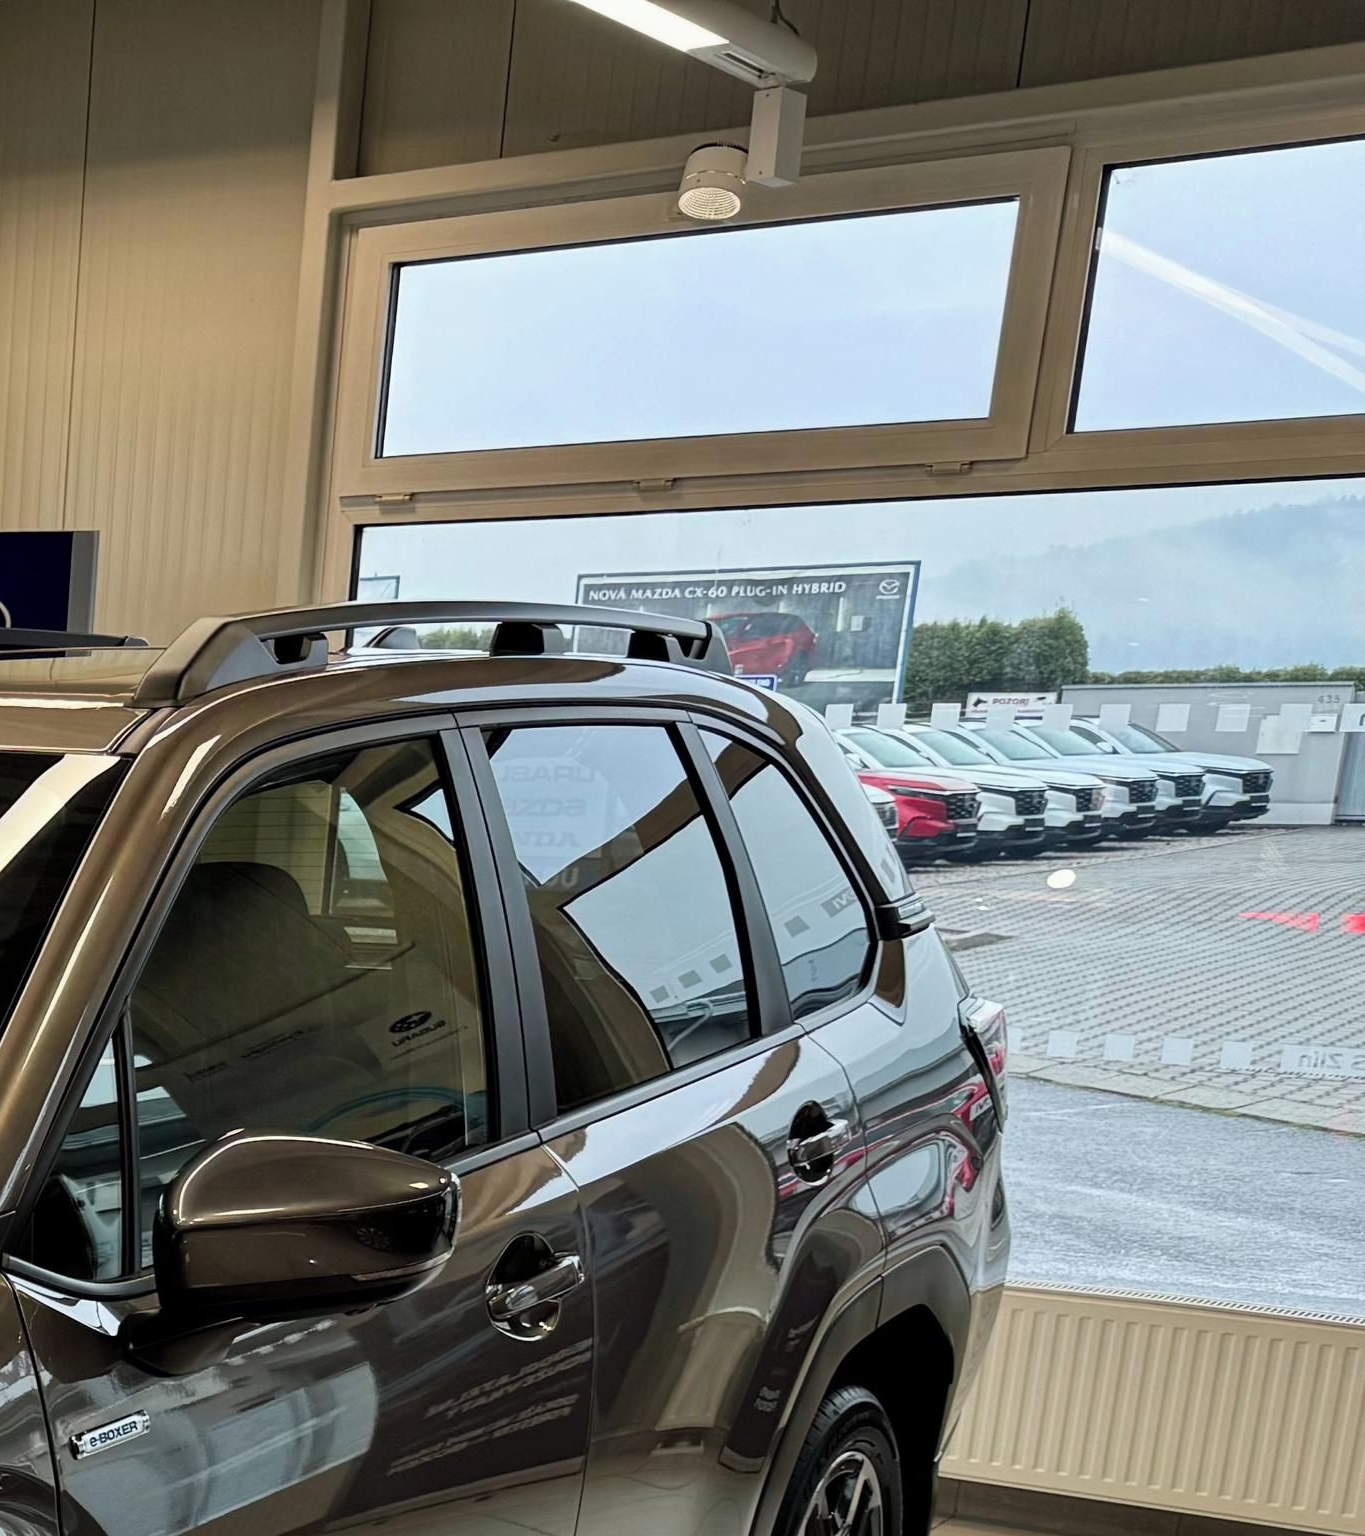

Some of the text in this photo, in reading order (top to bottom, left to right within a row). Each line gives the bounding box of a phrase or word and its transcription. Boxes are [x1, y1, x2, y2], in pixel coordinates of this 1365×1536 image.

[589, 581, 847, 601] NOVÁ MAZDA CX-60 PLUG-IN HYBRID
[89, 1420, 138, 1447] e-BOXER
